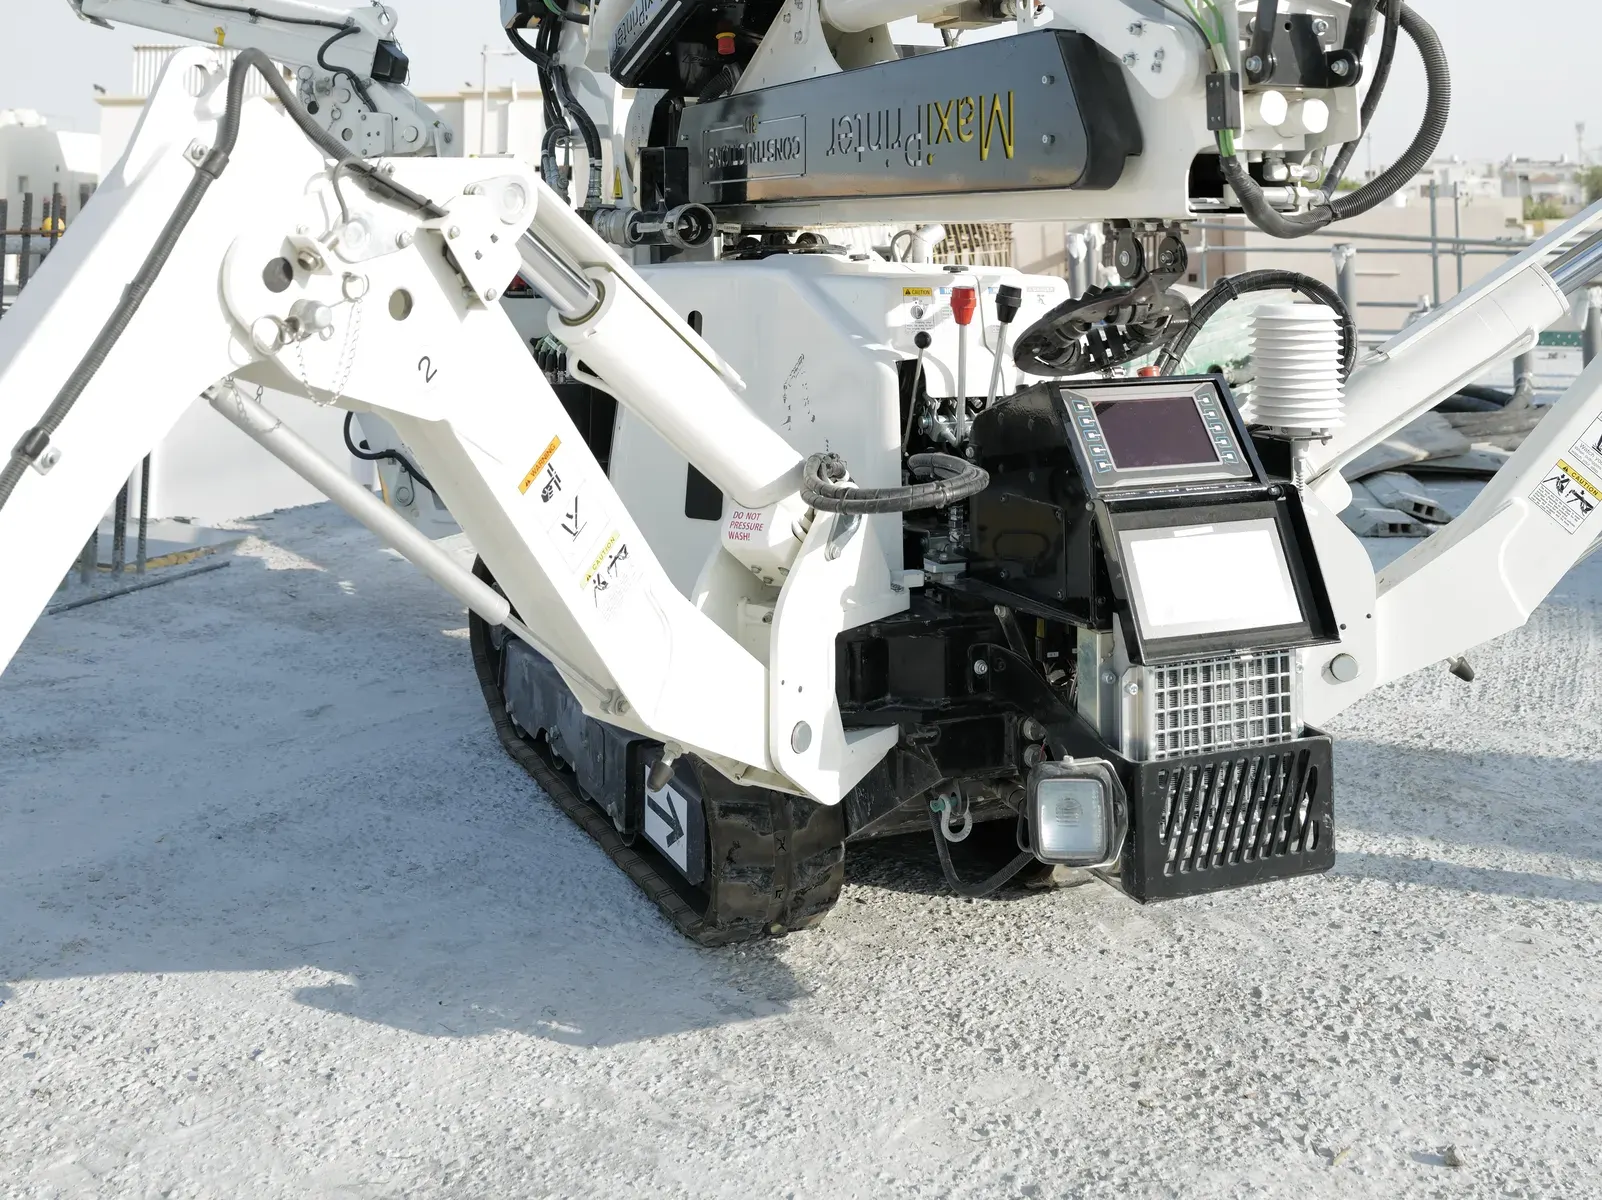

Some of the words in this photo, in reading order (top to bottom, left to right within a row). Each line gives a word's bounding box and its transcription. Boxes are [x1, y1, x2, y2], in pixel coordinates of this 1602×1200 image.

[826, 90, 1014, 167] MaxiPrinter
[707, 135, 800, 169] CONSTRUCTIONS
[418, 355, 438, 383] 2
[530, 443, 556, 477] WARNING
[1571, 472, 1599, 496] CAUTION
[729, 521, 764, 531] PRESSURE
[733, 511, 744, 519] DO
[745, 512, 761, 521] NOT
[728, 531, 751, 541] WASH!
[592, 536, 615, 571] CAUTION
